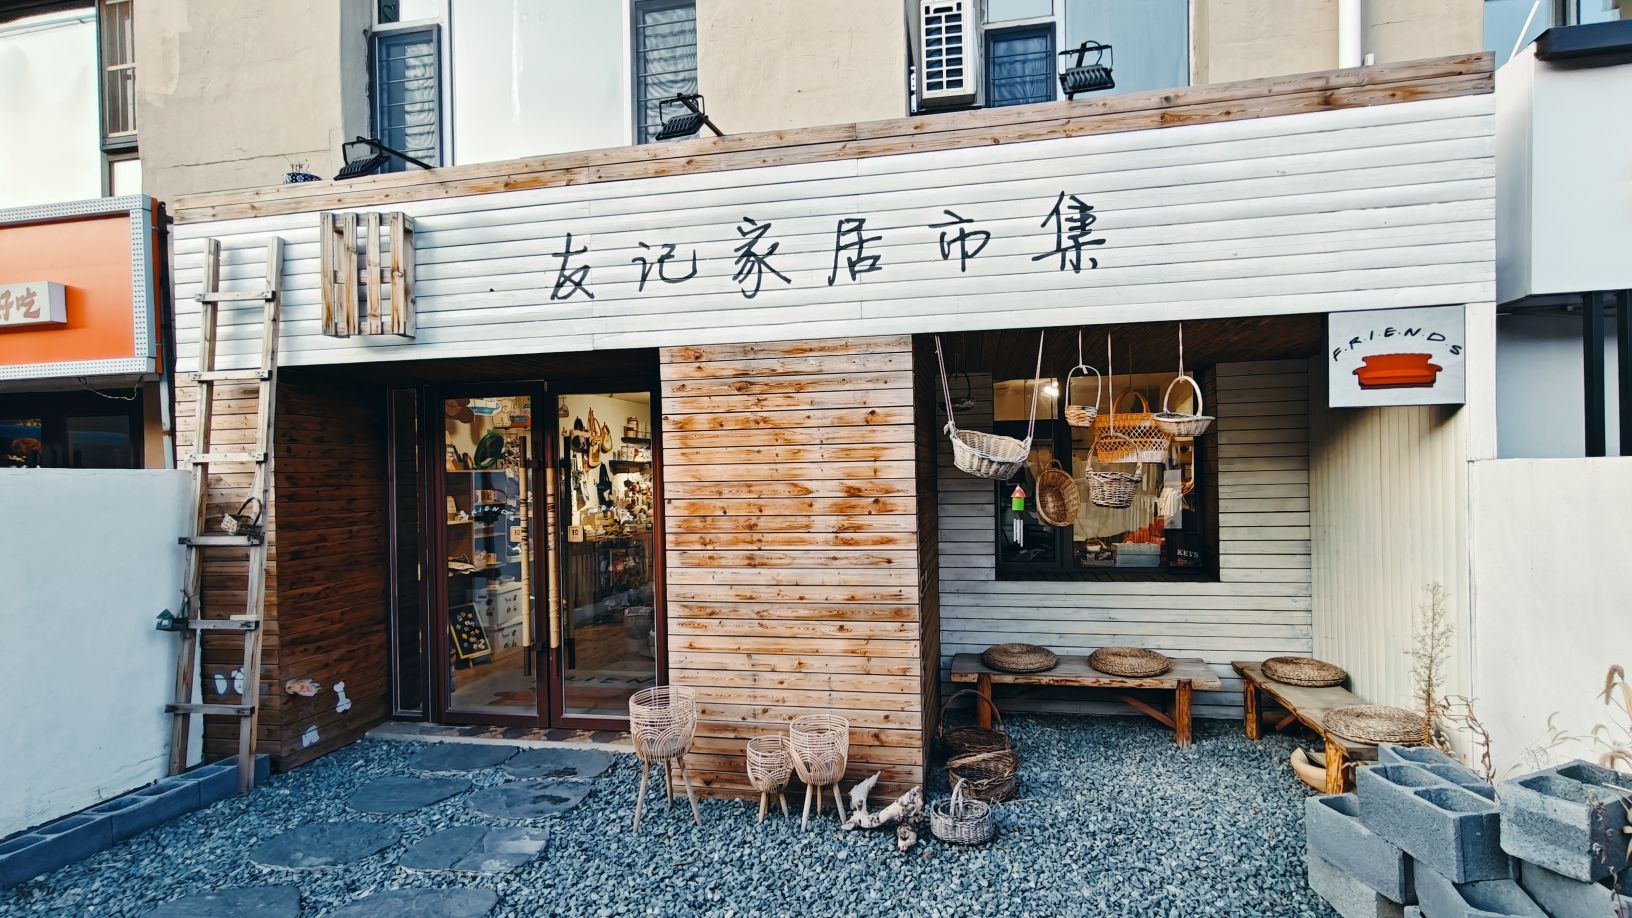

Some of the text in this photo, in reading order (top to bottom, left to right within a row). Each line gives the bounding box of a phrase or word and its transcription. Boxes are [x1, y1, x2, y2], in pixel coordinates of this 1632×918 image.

[550, 190, 1106, 299] 友记家居市集
